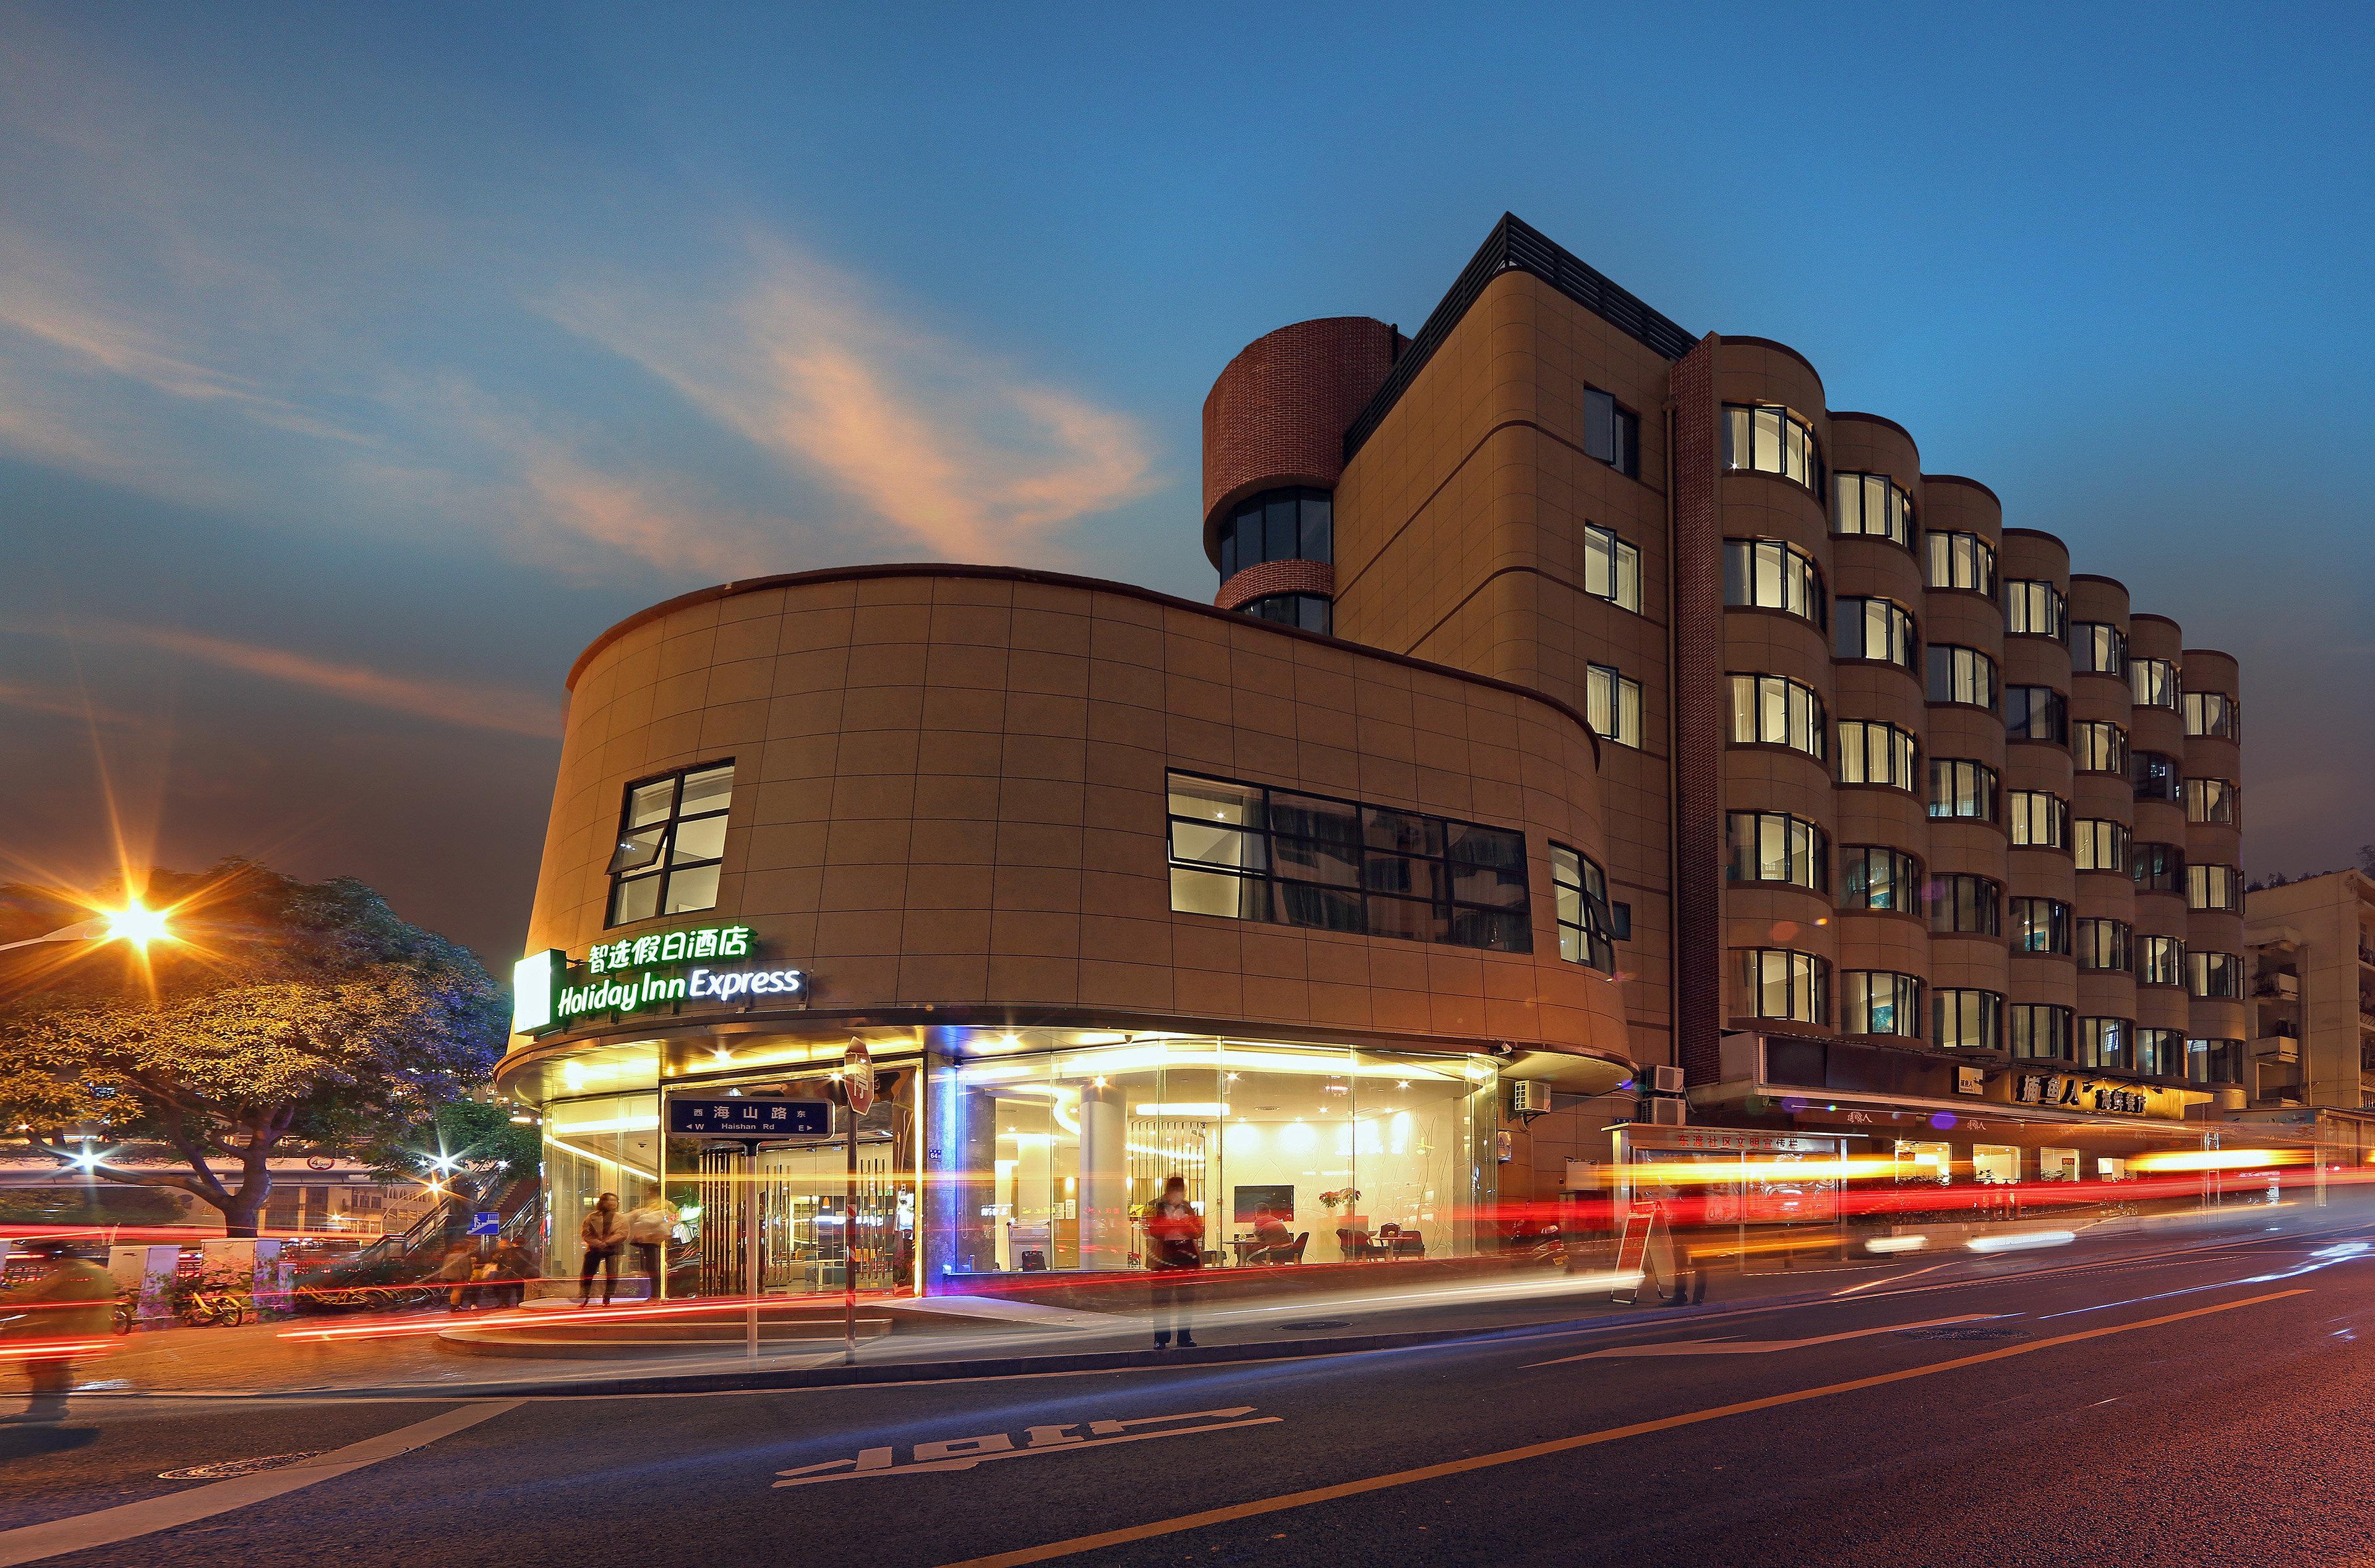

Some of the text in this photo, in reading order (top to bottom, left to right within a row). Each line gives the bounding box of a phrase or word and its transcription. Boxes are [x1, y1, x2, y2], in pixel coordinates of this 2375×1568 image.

[588, 926, 749, 974] 智选假日酒店
[557, 968, 800, 1018] Holiday Inn Express
[2021, 1075, 2081, 1106] 捕鱼人
[693, 1109, 703, 1117] 西
[713, 1106, 787, 1120] 海山路
[1677, 1133, 1799, 1150] 东渡社区文明宣传栏
